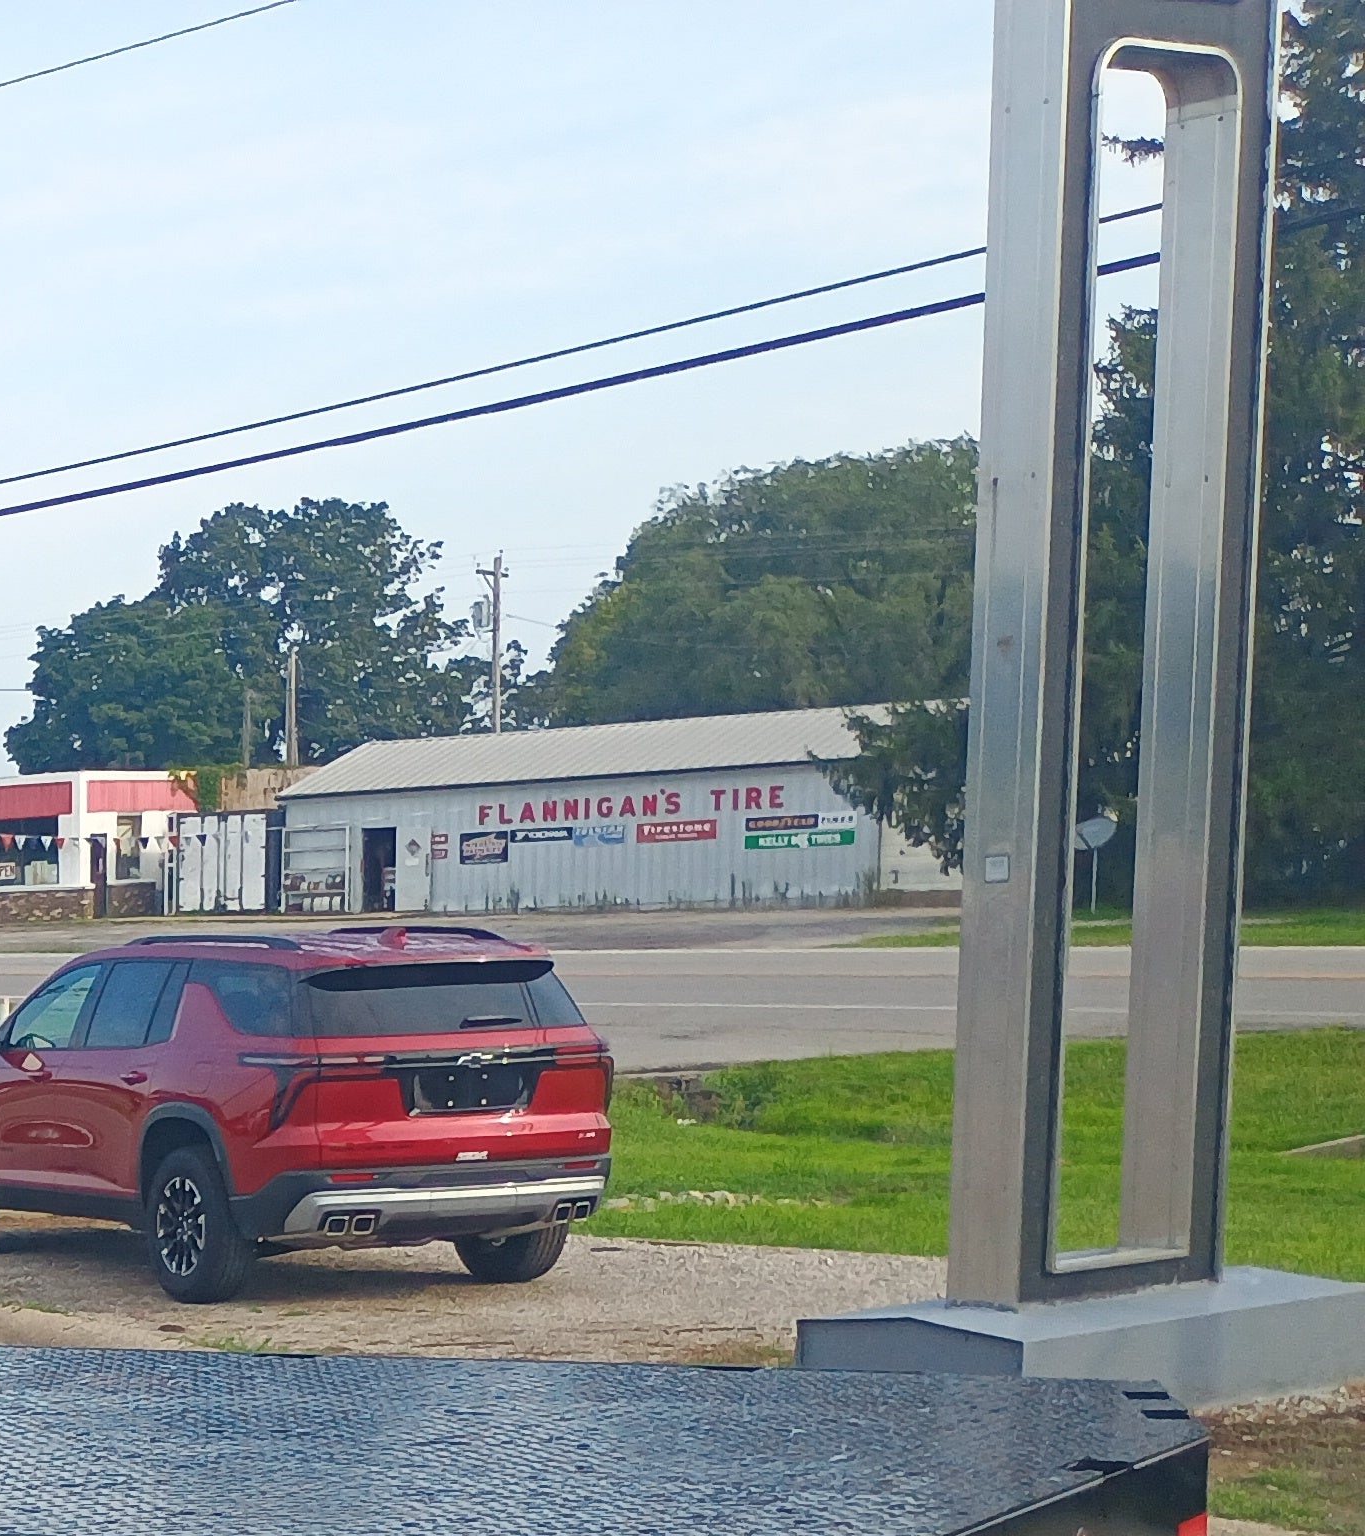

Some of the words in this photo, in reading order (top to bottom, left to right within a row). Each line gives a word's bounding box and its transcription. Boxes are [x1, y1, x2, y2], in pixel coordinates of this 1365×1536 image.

[478, 788, 682, 826] FLANNIGAN'S
[710, 785, 785, 811] TIRE
[643, 823, 711, 836] Firestone
